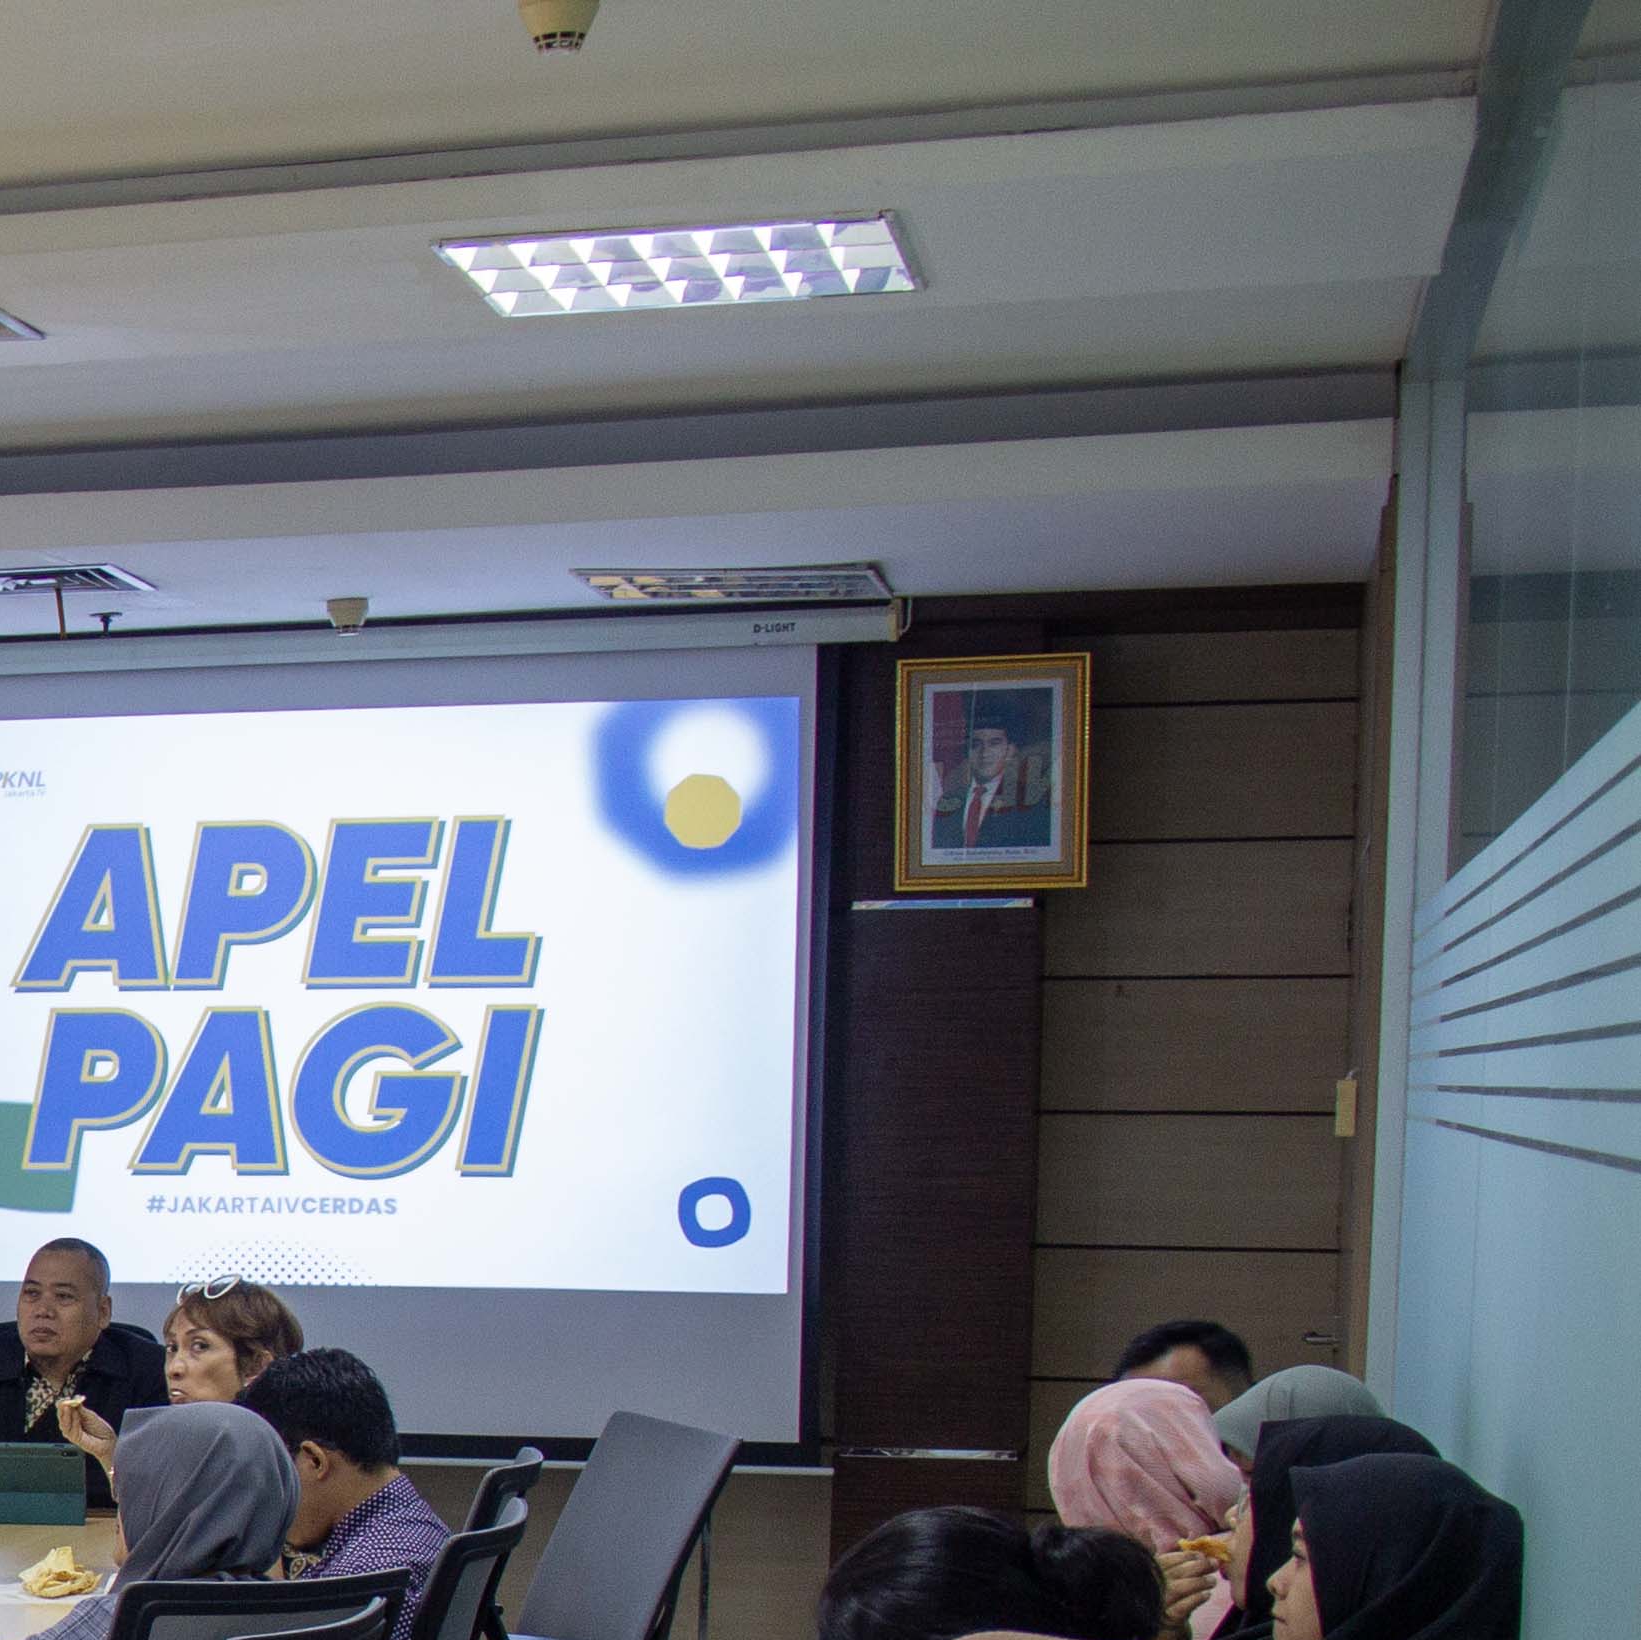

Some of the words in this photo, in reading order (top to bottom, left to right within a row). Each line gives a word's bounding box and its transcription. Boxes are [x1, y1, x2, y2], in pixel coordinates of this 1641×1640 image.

[753, 622, 796, 633] D-LIGHT
[11, 814, 544, 993] APEL
[22, 1001, 545, 1180] PAGI
[146, 1195, 398, 1215] #JAKARTAIVCERDAS
